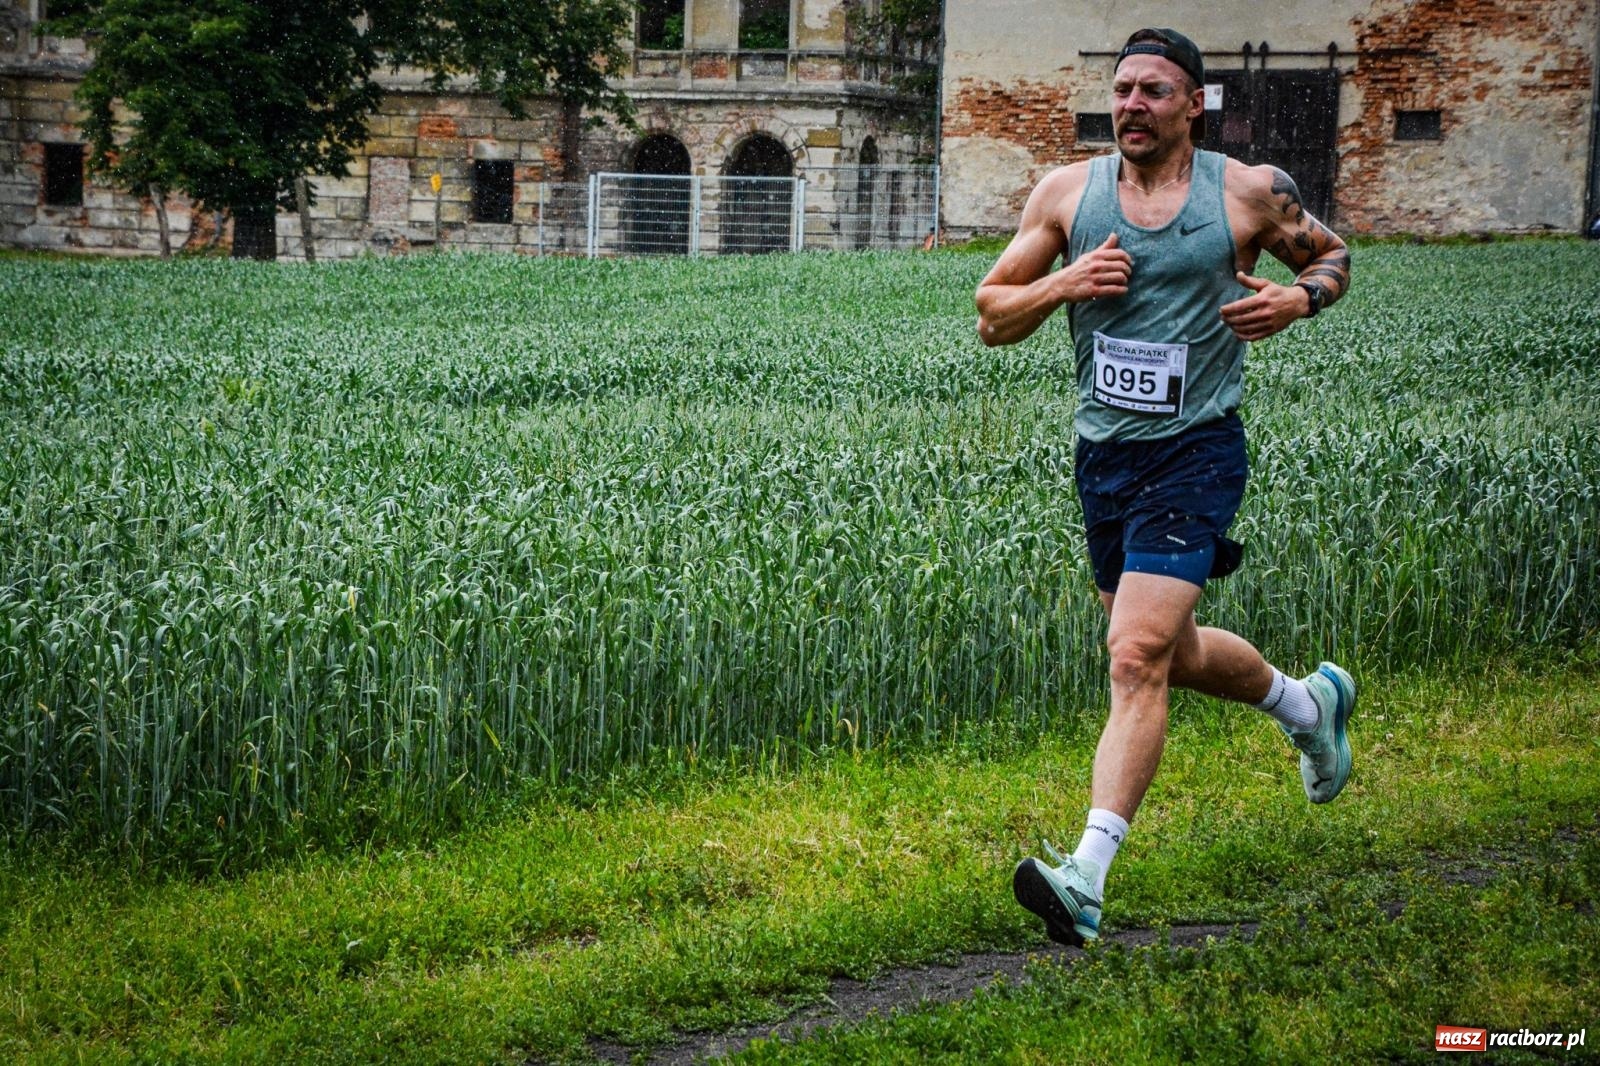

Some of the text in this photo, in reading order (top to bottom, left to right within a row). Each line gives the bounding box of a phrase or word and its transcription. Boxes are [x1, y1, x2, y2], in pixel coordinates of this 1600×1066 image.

[1107, 343, 1123, 353] BIEG
[1124, 347, 1136, 355] NA
[1103, 364, 1156, 395] 095
